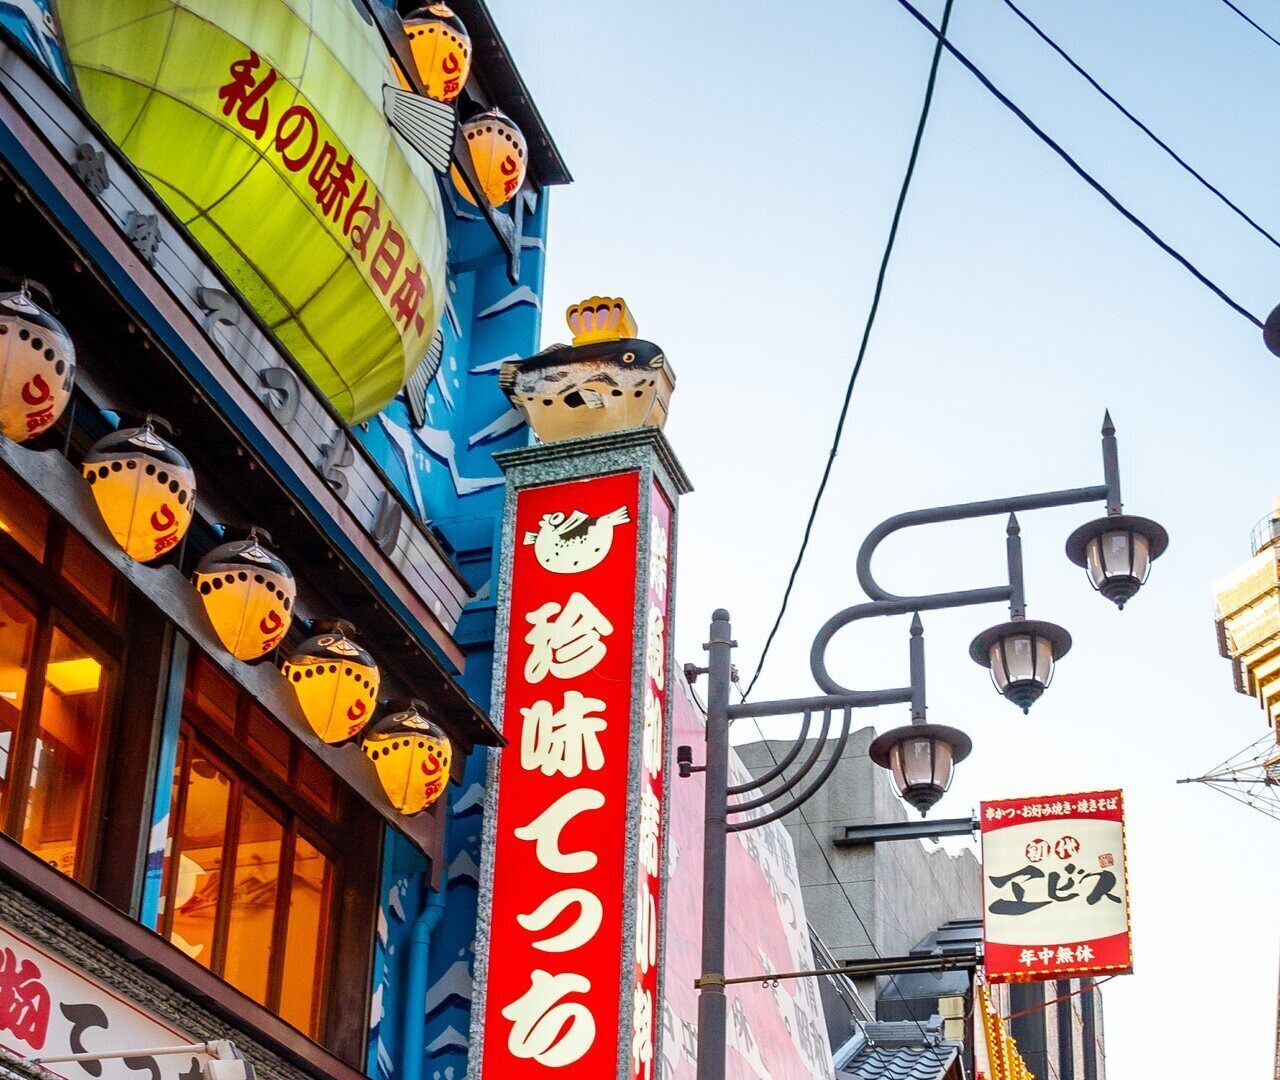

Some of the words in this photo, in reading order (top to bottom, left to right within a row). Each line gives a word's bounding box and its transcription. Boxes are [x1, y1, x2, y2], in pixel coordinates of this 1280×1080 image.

[988, 863, 1122, 916] エビス
[1018, 944, 1095, 967] 年中無休
